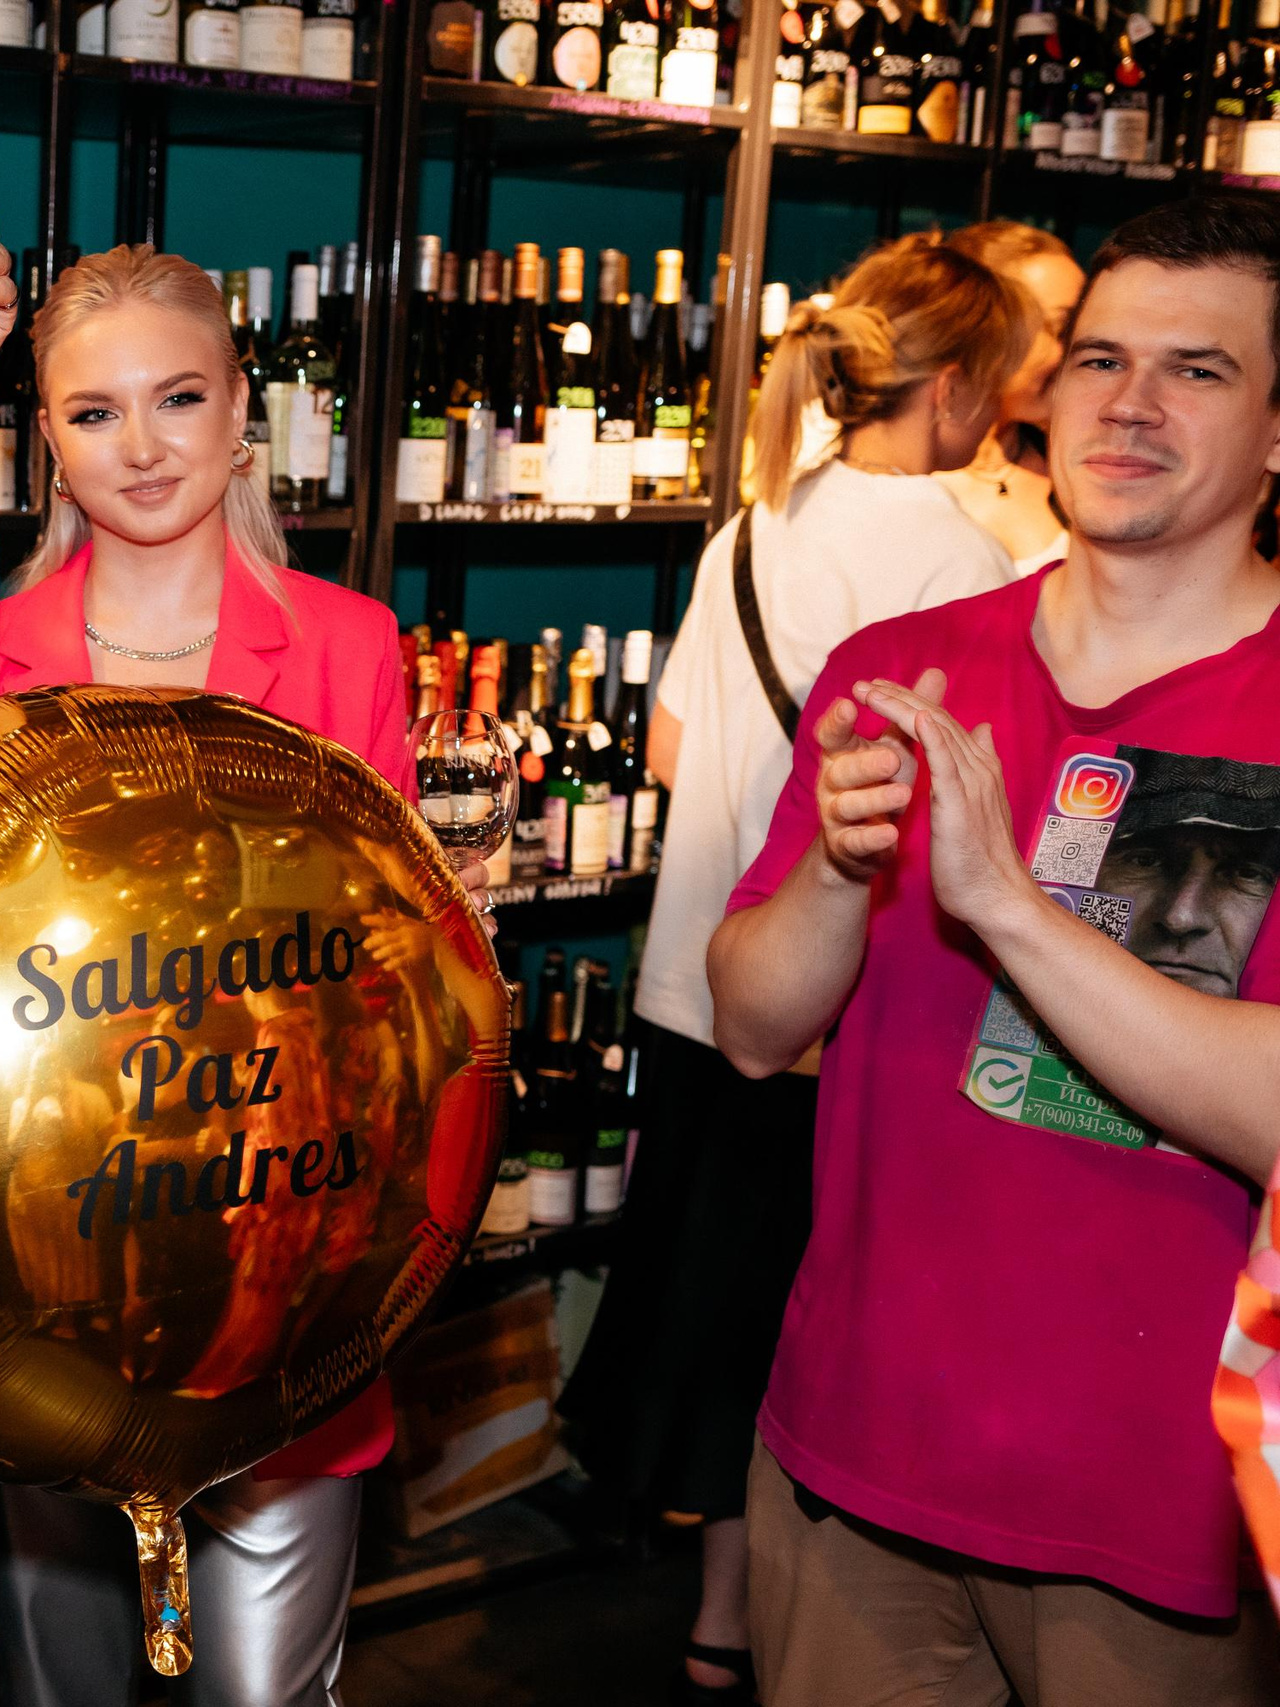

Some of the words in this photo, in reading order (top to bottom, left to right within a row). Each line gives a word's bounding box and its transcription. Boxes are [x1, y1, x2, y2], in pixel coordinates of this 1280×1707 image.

[12, 911, 365, 1031] Salgado
[121, 1035, 282, 1121] Paz
[1023, 1103, 1145, 1143] +7(900)341-93-09
[67, 1130, 366, 1240] Andres
